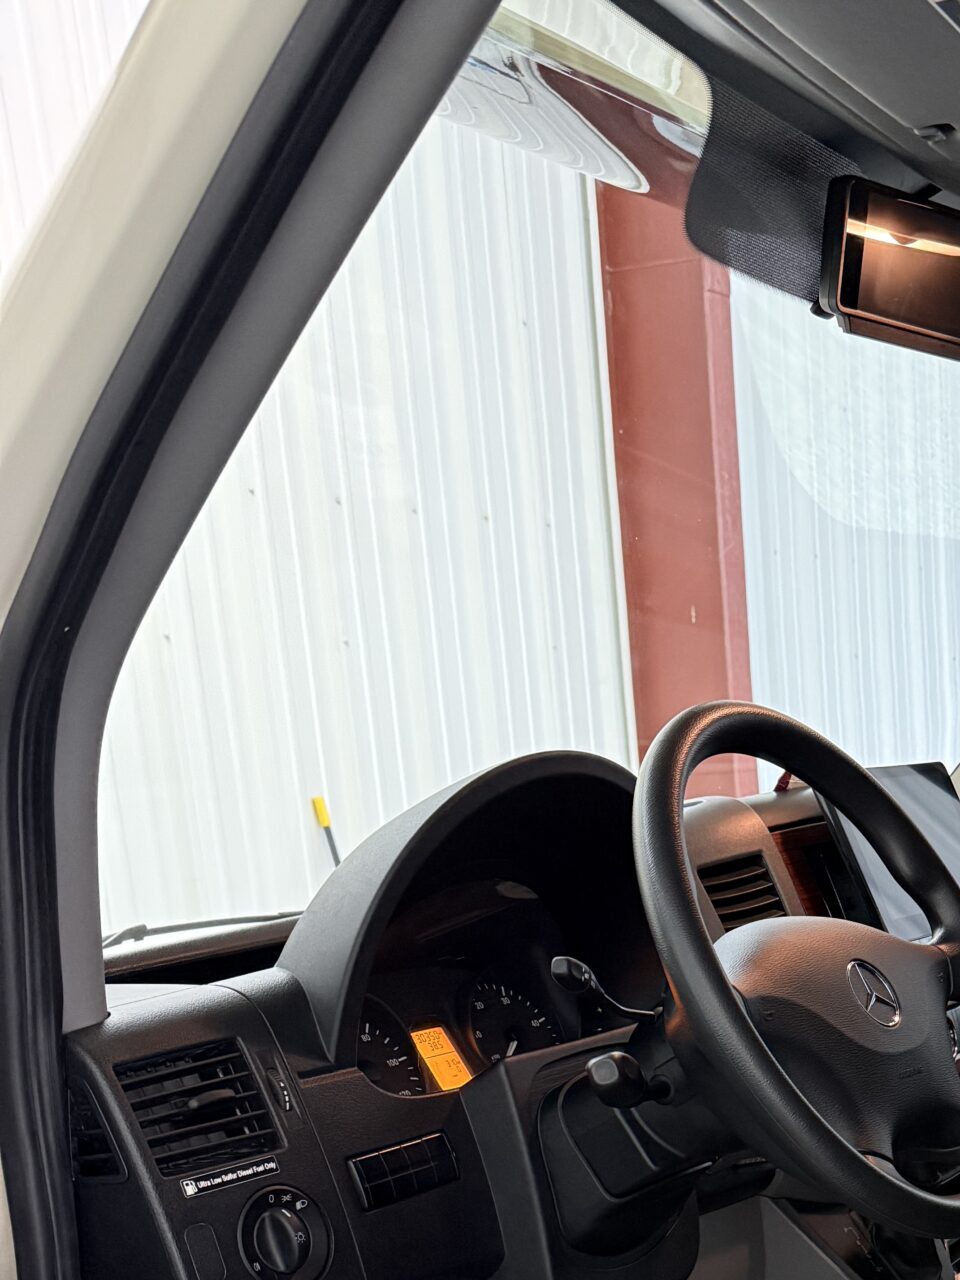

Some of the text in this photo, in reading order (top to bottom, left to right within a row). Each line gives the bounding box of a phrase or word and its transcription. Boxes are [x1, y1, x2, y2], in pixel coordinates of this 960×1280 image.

[501, 997, 511, 1005] 30
[531, 1019, 540, 1028] 40
[361, 1033, 371, 1043] 80
[386, 1058, 399, 1067] 100
[197, 1161, 276, 1188] Ultra Low Sulfur Diesel Fuel Only
